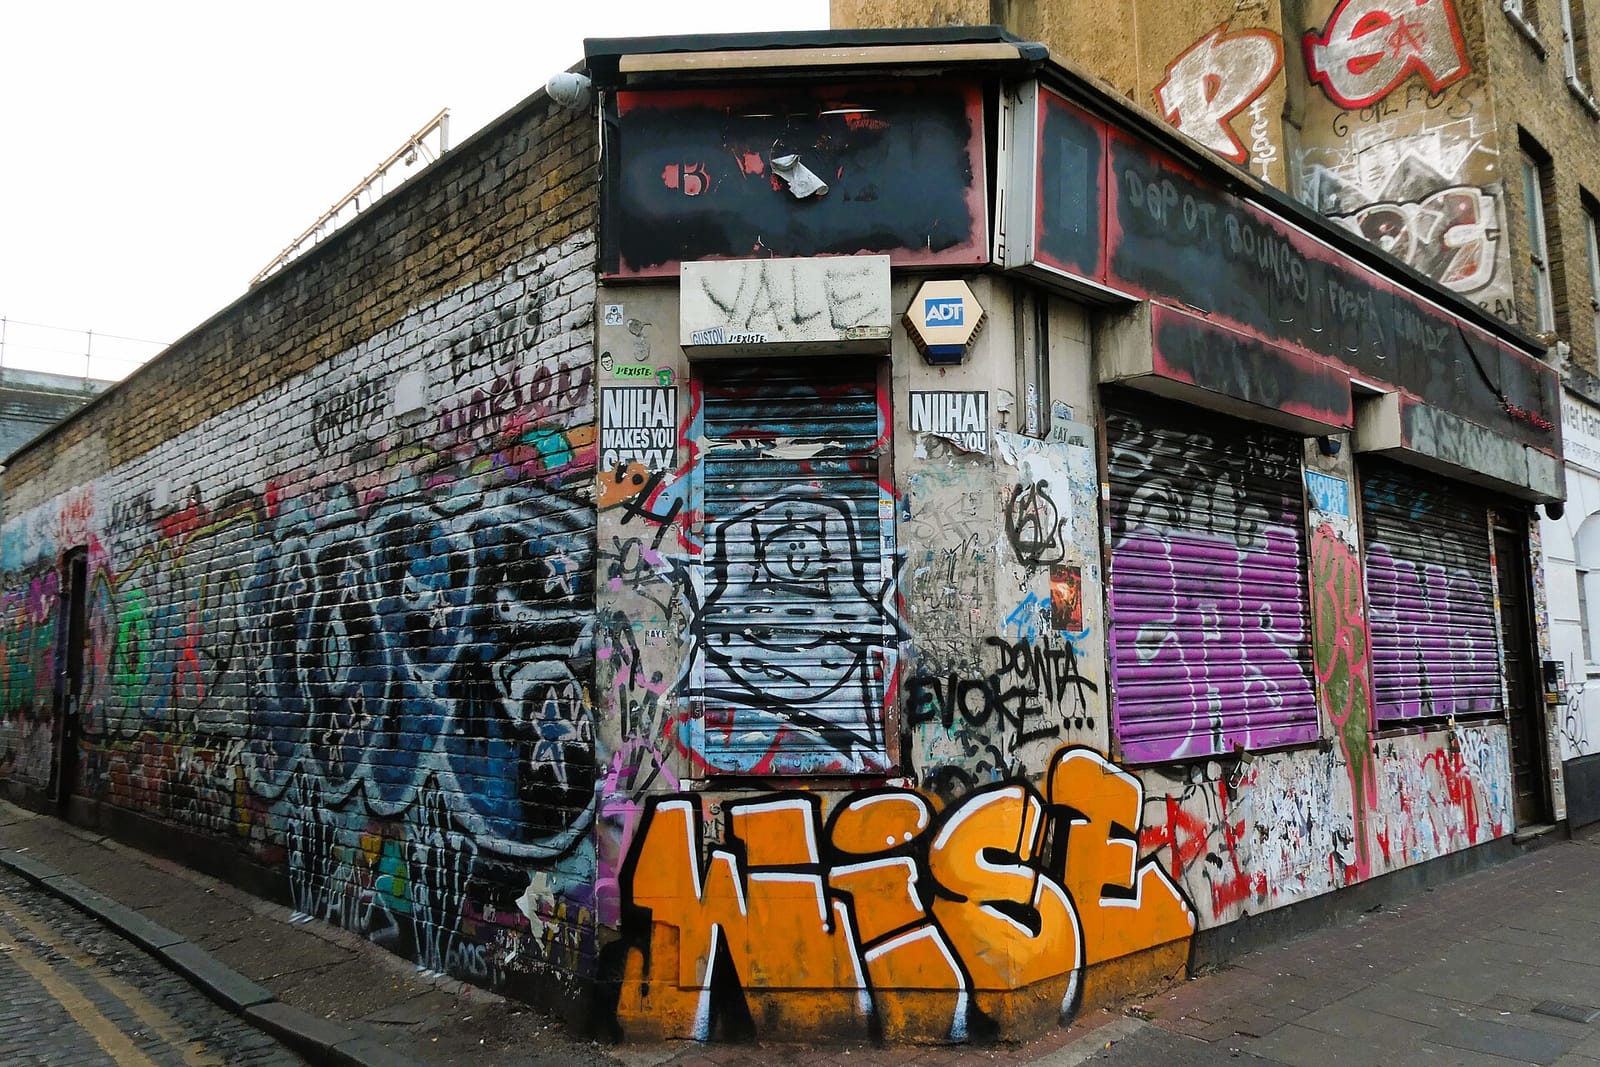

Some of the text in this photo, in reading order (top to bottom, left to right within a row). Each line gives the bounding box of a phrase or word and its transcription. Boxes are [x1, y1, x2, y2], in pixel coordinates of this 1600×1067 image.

[925, 303, 963, 321] ADT
[602, 389, 676, 429] NIIHAI
[911, 393, 986, 432] NIIHAI
[602, 428, 675, 449] MAKES YOU
